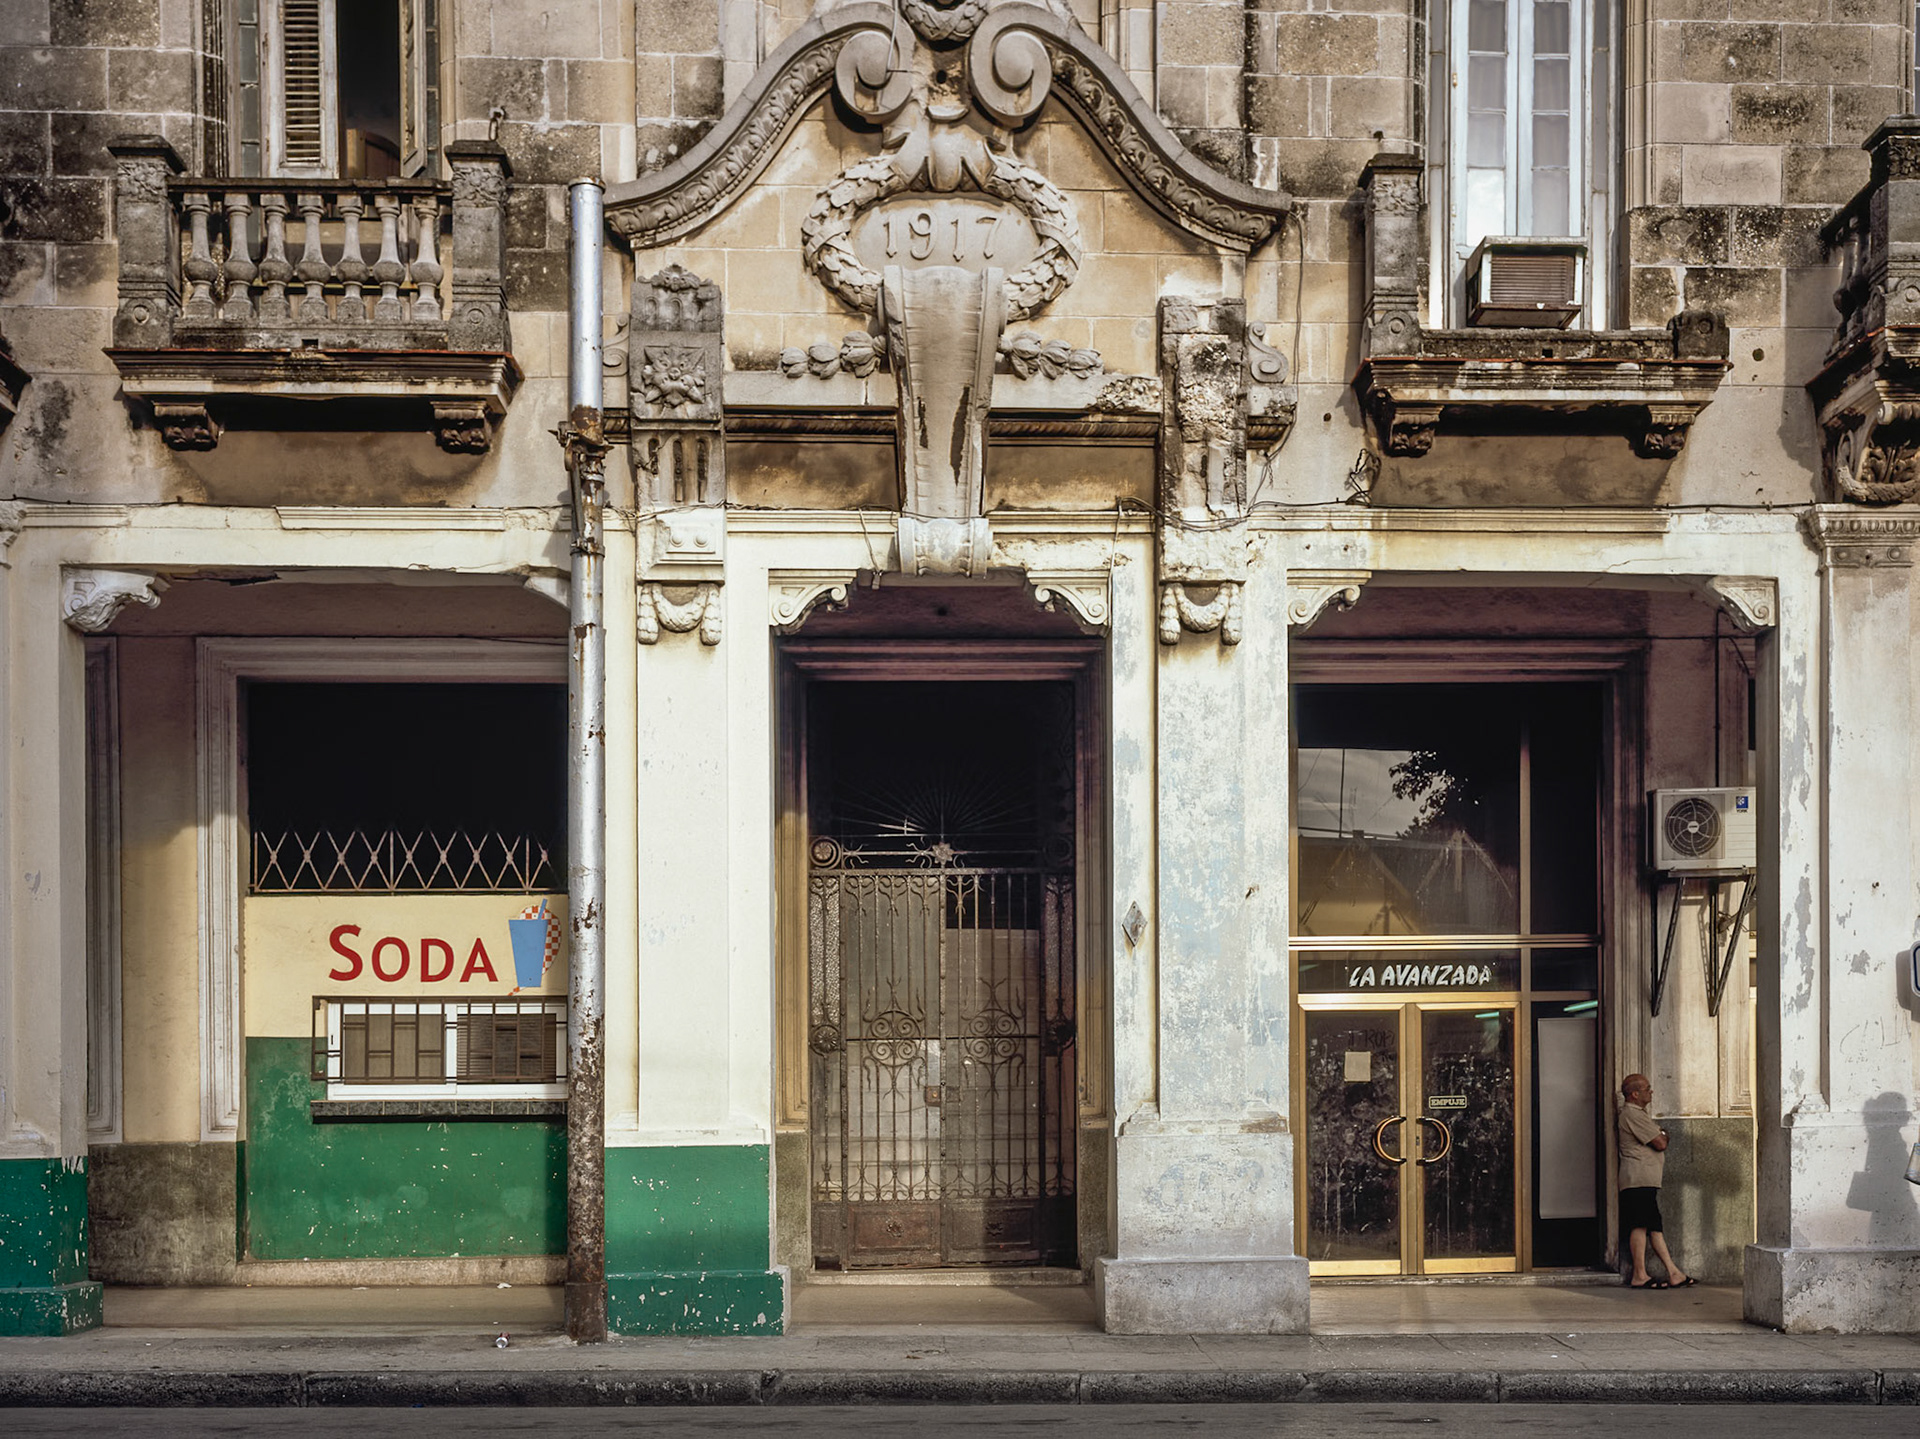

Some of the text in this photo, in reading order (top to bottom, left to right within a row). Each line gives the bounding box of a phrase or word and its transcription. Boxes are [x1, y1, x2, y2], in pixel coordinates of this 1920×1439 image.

[883, 209, 1003, 262] 1917
[328, 924, 499, 983] SODA
[1349, 964, 1492, 987] LA AVANZADA
[1431, 1098, 1466, 1106] EMPUJE
